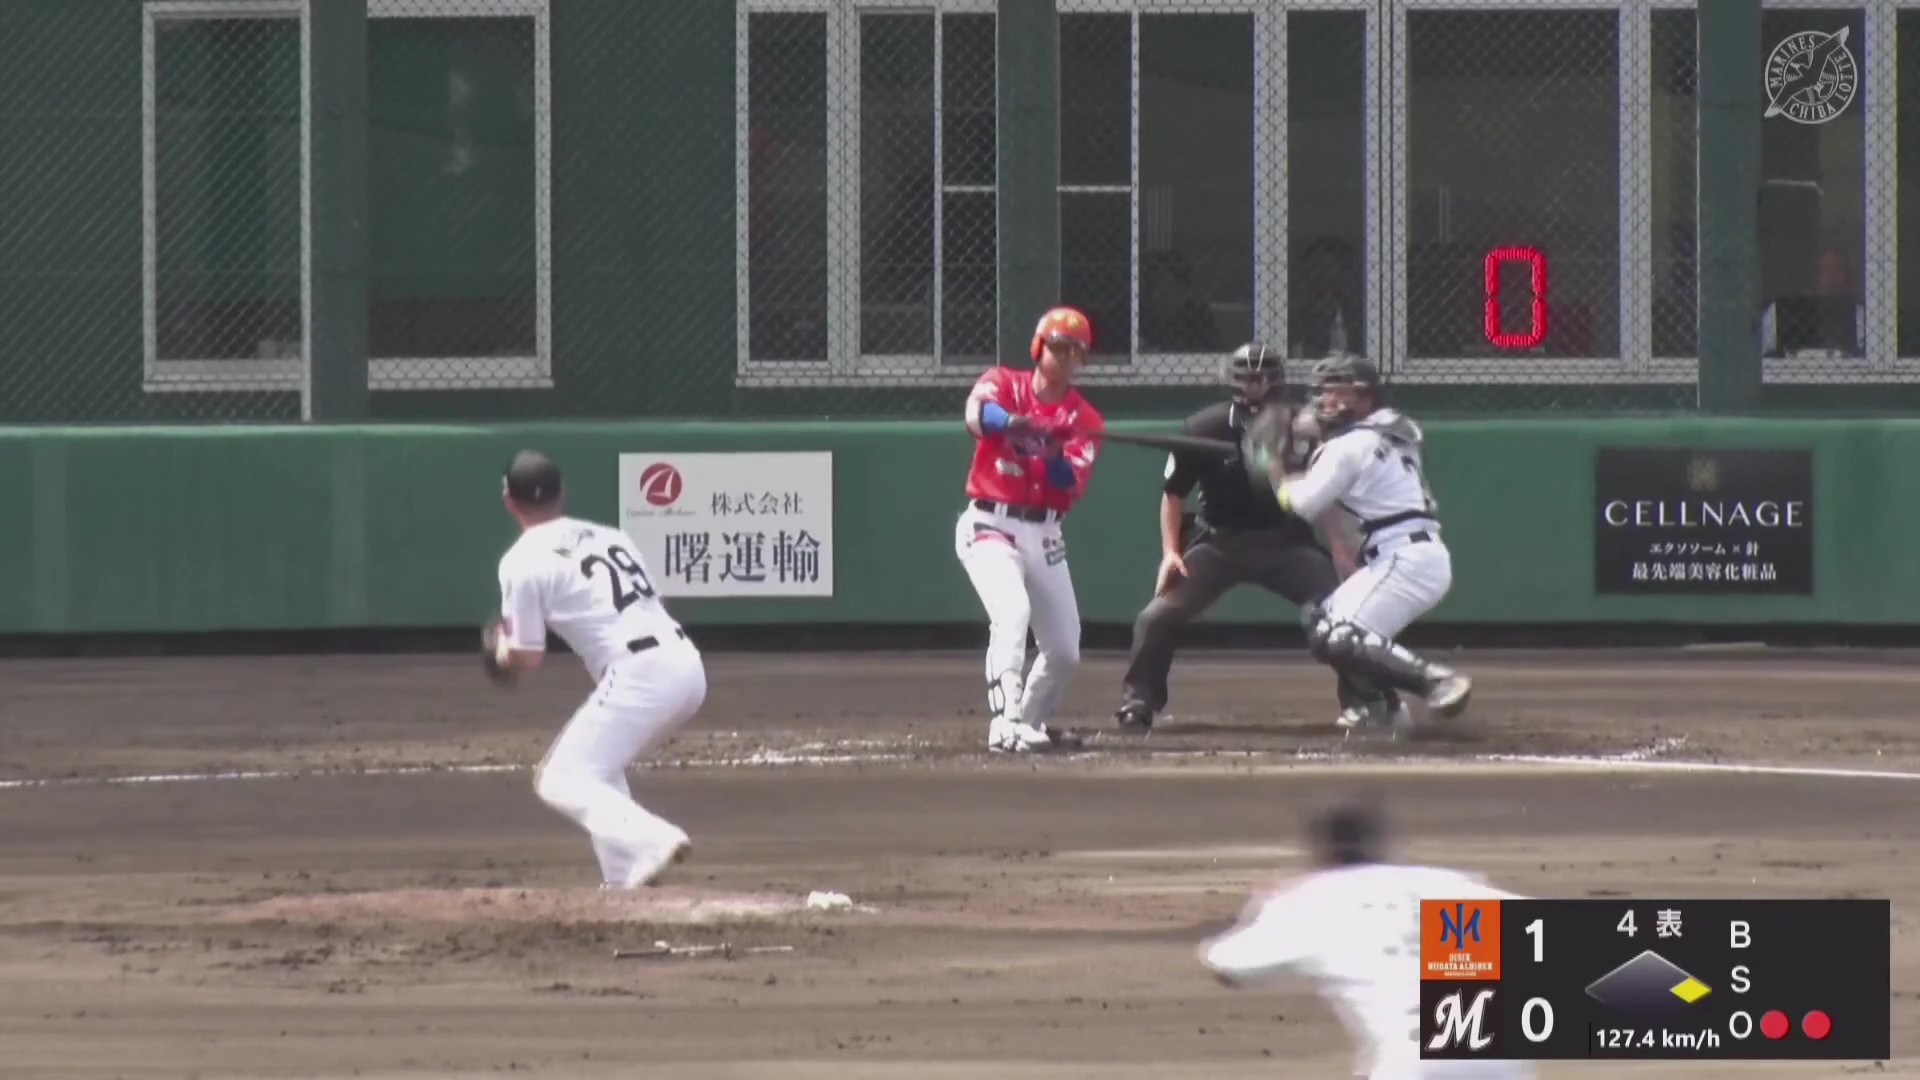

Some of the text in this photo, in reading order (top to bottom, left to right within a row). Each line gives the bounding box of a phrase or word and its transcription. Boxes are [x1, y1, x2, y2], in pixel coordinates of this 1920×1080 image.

[1485, 247, 1547, 346] 0
[710, 491, 803, 516] 株式会社
[1604, 500, 1803, 526] CELLNAGE
[664, 529, 821, 584] 曙運輸
[1632, 562, 1776, 581] 最先端美容化粧品
[580, 544, 655, 614] 29
